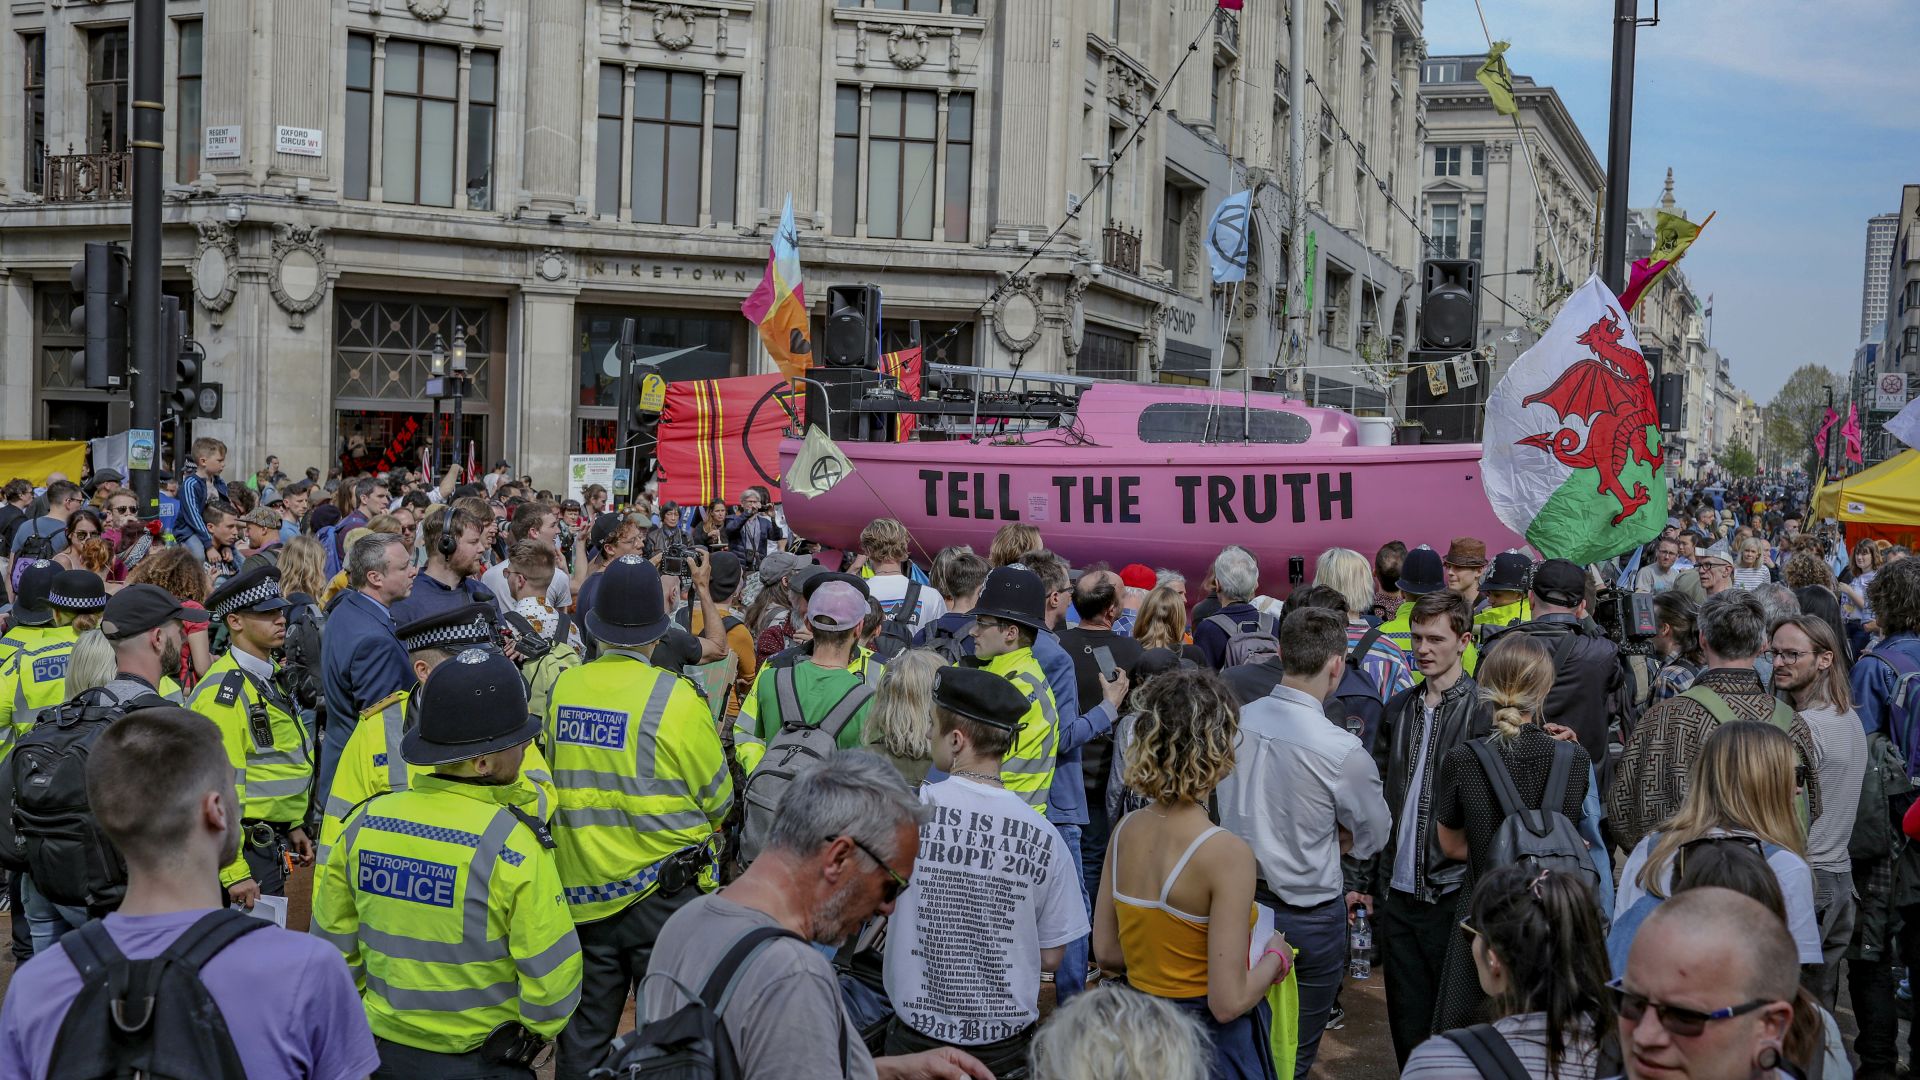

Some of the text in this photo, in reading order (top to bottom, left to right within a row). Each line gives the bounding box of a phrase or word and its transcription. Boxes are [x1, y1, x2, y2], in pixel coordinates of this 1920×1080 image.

[208, 128, 228, 137] REGENT
[280, 128, 308, 138] OXFORD
[280, 136, 318, 148] CIRCUS W1
[594, 263, 746, 283] NIKETOWN
[1461, 374, 1474, 382] LIFE
[919, 469, 1020, 521] TELL
[1052, 476, 1141, 524] THE
[1174, 472, 1353, 524] TRUTH
[560, 709, 622, 724] METROPOLITAN
[558, 720, 620, 744] POLICE
[969, 812, 994, 832] IS
[916, 840, 996, 870] UROPE
[360, 852, 455, 880] METROPOLITAN
[360, 866, 452, 904] POLICE
